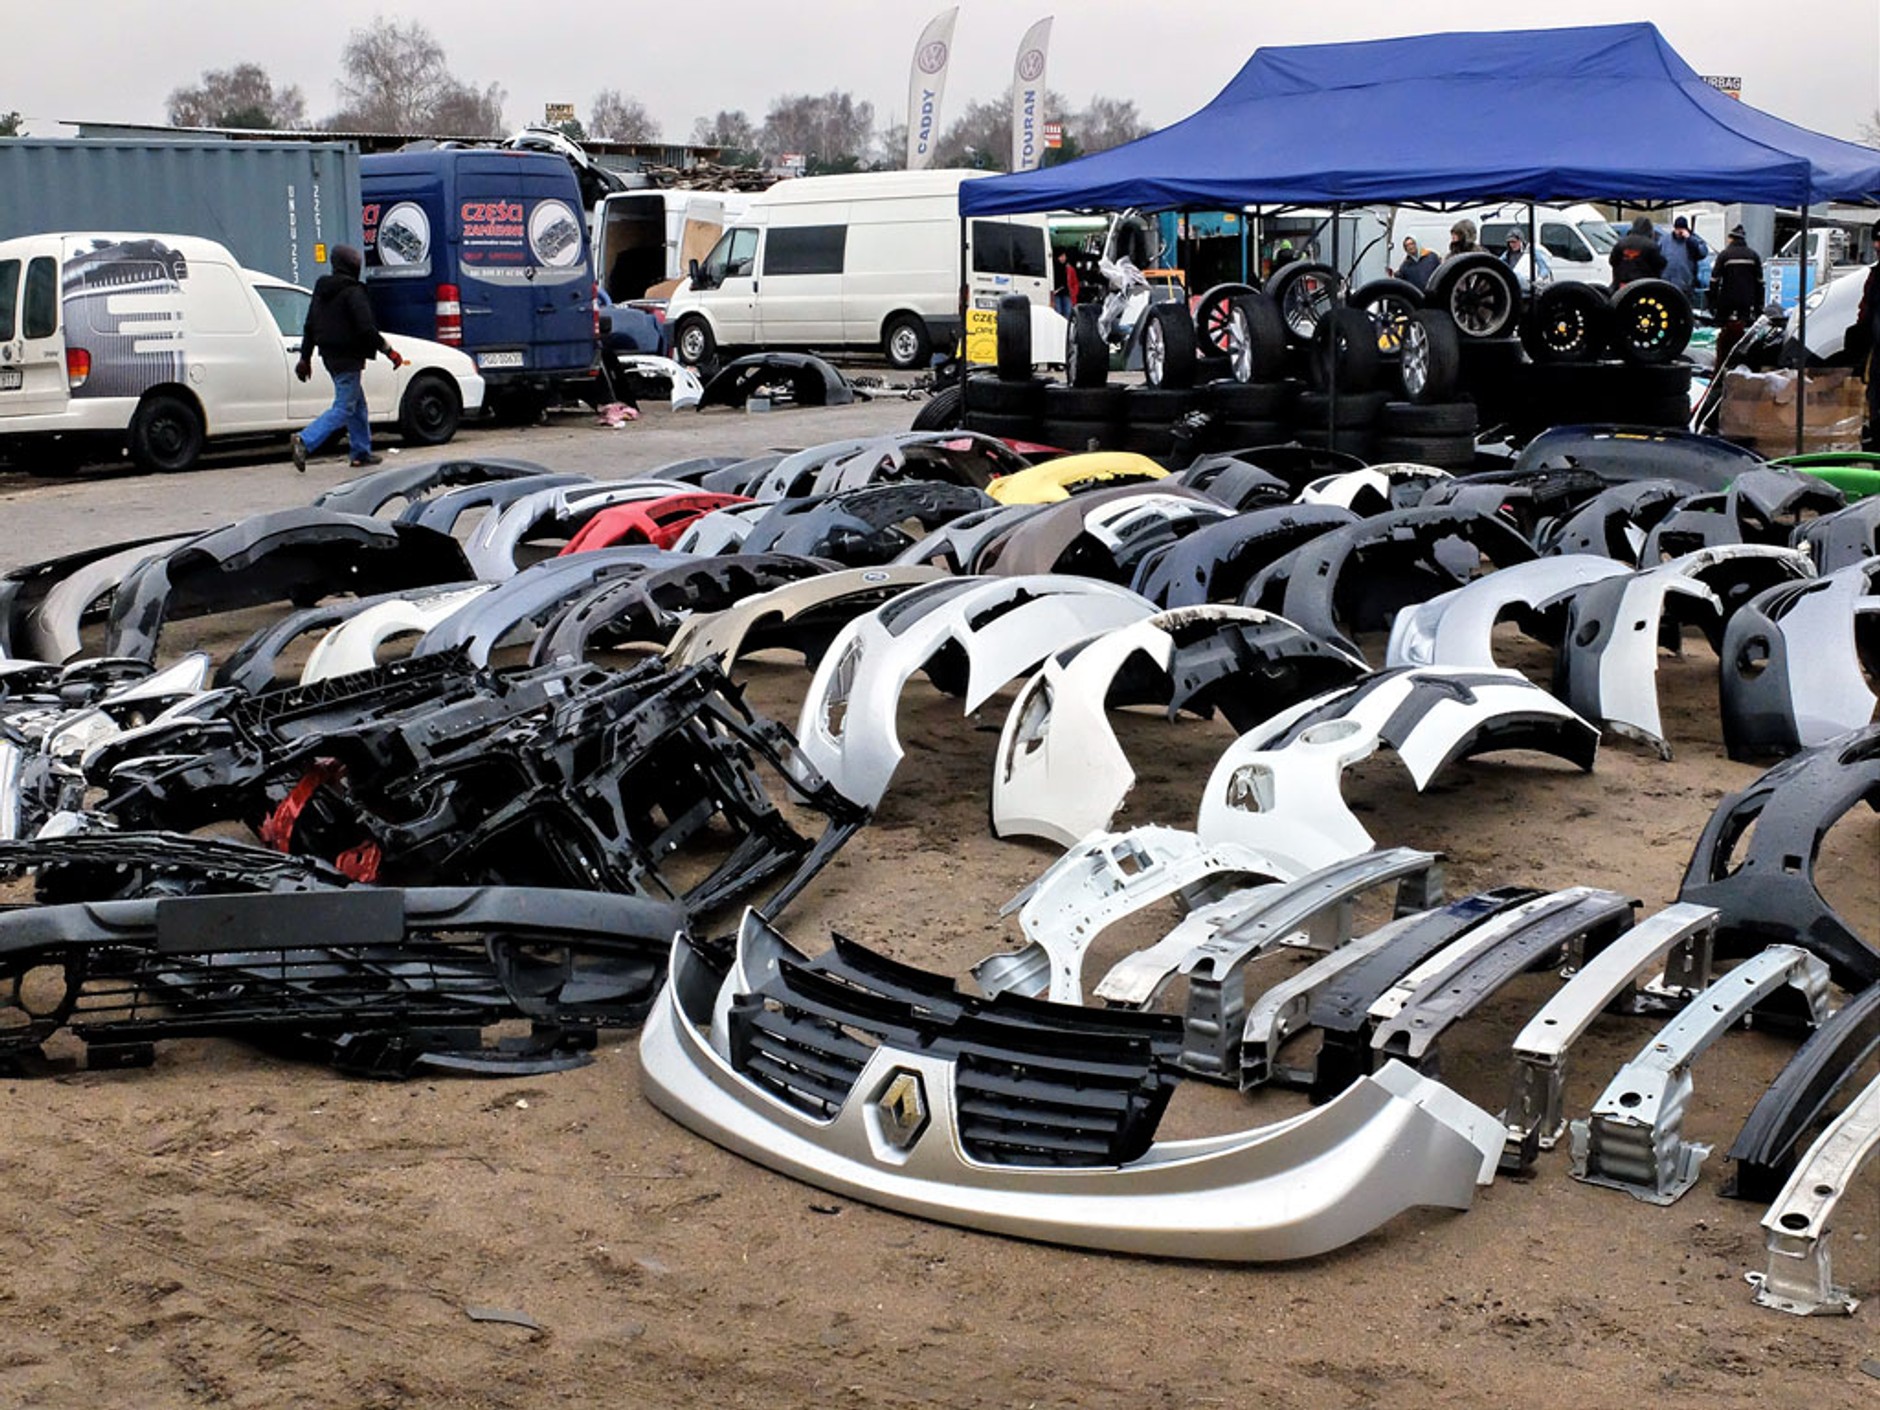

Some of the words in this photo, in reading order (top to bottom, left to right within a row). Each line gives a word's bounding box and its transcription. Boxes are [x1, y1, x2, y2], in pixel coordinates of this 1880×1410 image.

[918, 89, 936, 154] CADDY
[1022, 90, 1036, 168] TOURAN
[461, 200, 523, 225] CZĘŚCI
